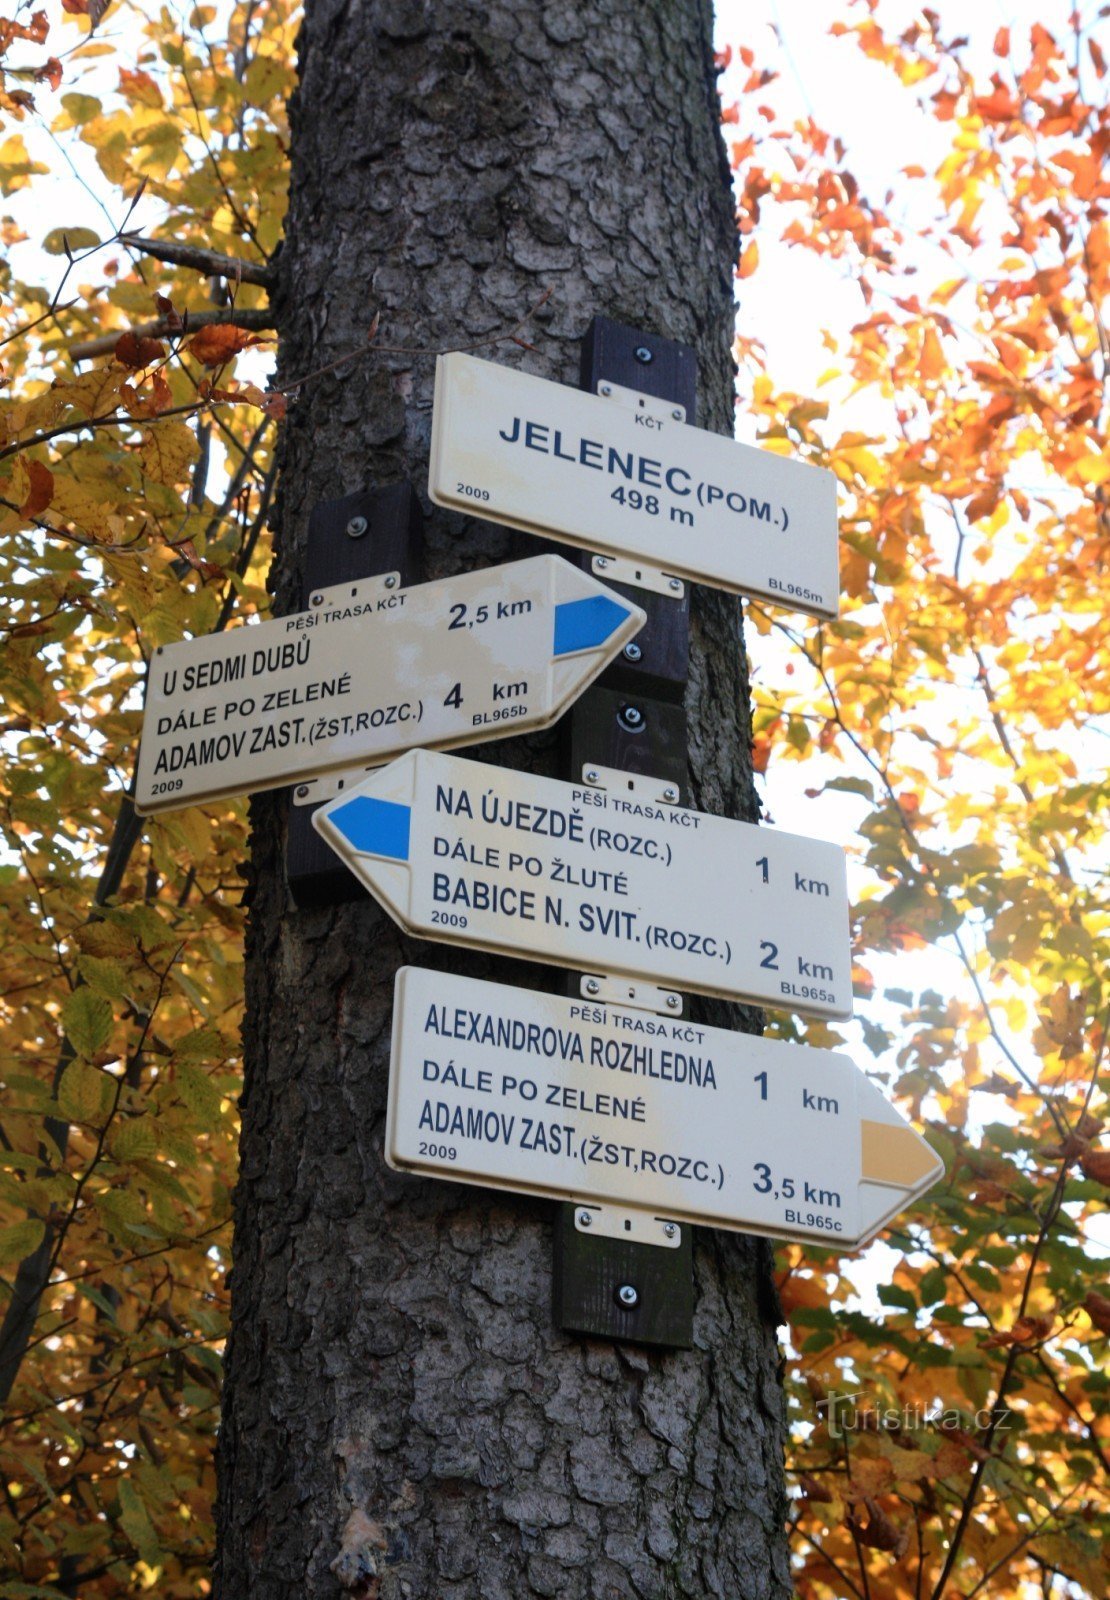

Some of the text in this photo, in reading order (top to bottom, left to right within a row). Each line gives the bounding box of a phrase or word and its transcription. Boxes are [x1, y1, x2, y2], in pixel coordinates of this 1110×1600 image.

[634, 413, 664, 431] KČT
[456, 483, 490, 501] 2009
[611, 486, 694, 527] 498 m
[768, 578, 823, 604] BL965m
[286, 595, 407, 632] PĚŠÍ TRASA KČT
[448, 600, 532, 630] 2,5 km
[163, 634, 311, 696] U SEDMI DUBŮ
[157, 672, 351, 735] DÁLE PO ZELENÉ
[443, 681, 528, 709] 4 km
[472, 705, 527, 726] BL965b
[153, 731, 246, 775] ADAMOV
[151, 779, 183, 796] 2009
[435, 784, 473, 819] NA
[572, 790, 700, 829] PĚŠÍ TRASA KČT
[433, 836, 628, 896] DÁLE PO ŽLUTÉ
[756, 856, 830, 897] 1 km
[431, 910, 468, 929] 2009
[433, 872, 535, 921] BABICE
[545, 895, 570, 928] N.
[578, 903, 640, 942] SVIT.
[759, 941, 834, 981] 2 km
[780, 981, 836, 1003] BL965a
[570, 1005, 705, 1045] PĚŠÍ TRASA KČT
[424, 1003, 717, 1090] ALEXANDROVA ROZHLEDNA
[422, 1060, 646, 1123] DÁLE PO ZELENÉ
[754, 1071, 839, 1114] 1 km
[418, 1099, 515, 1146] ADAMOV
[418, 1142, 457, 1160] 2009
[753, 1163, 841, 1208] 3,5 km
[785, 1209, 842, 1232] BL965c
